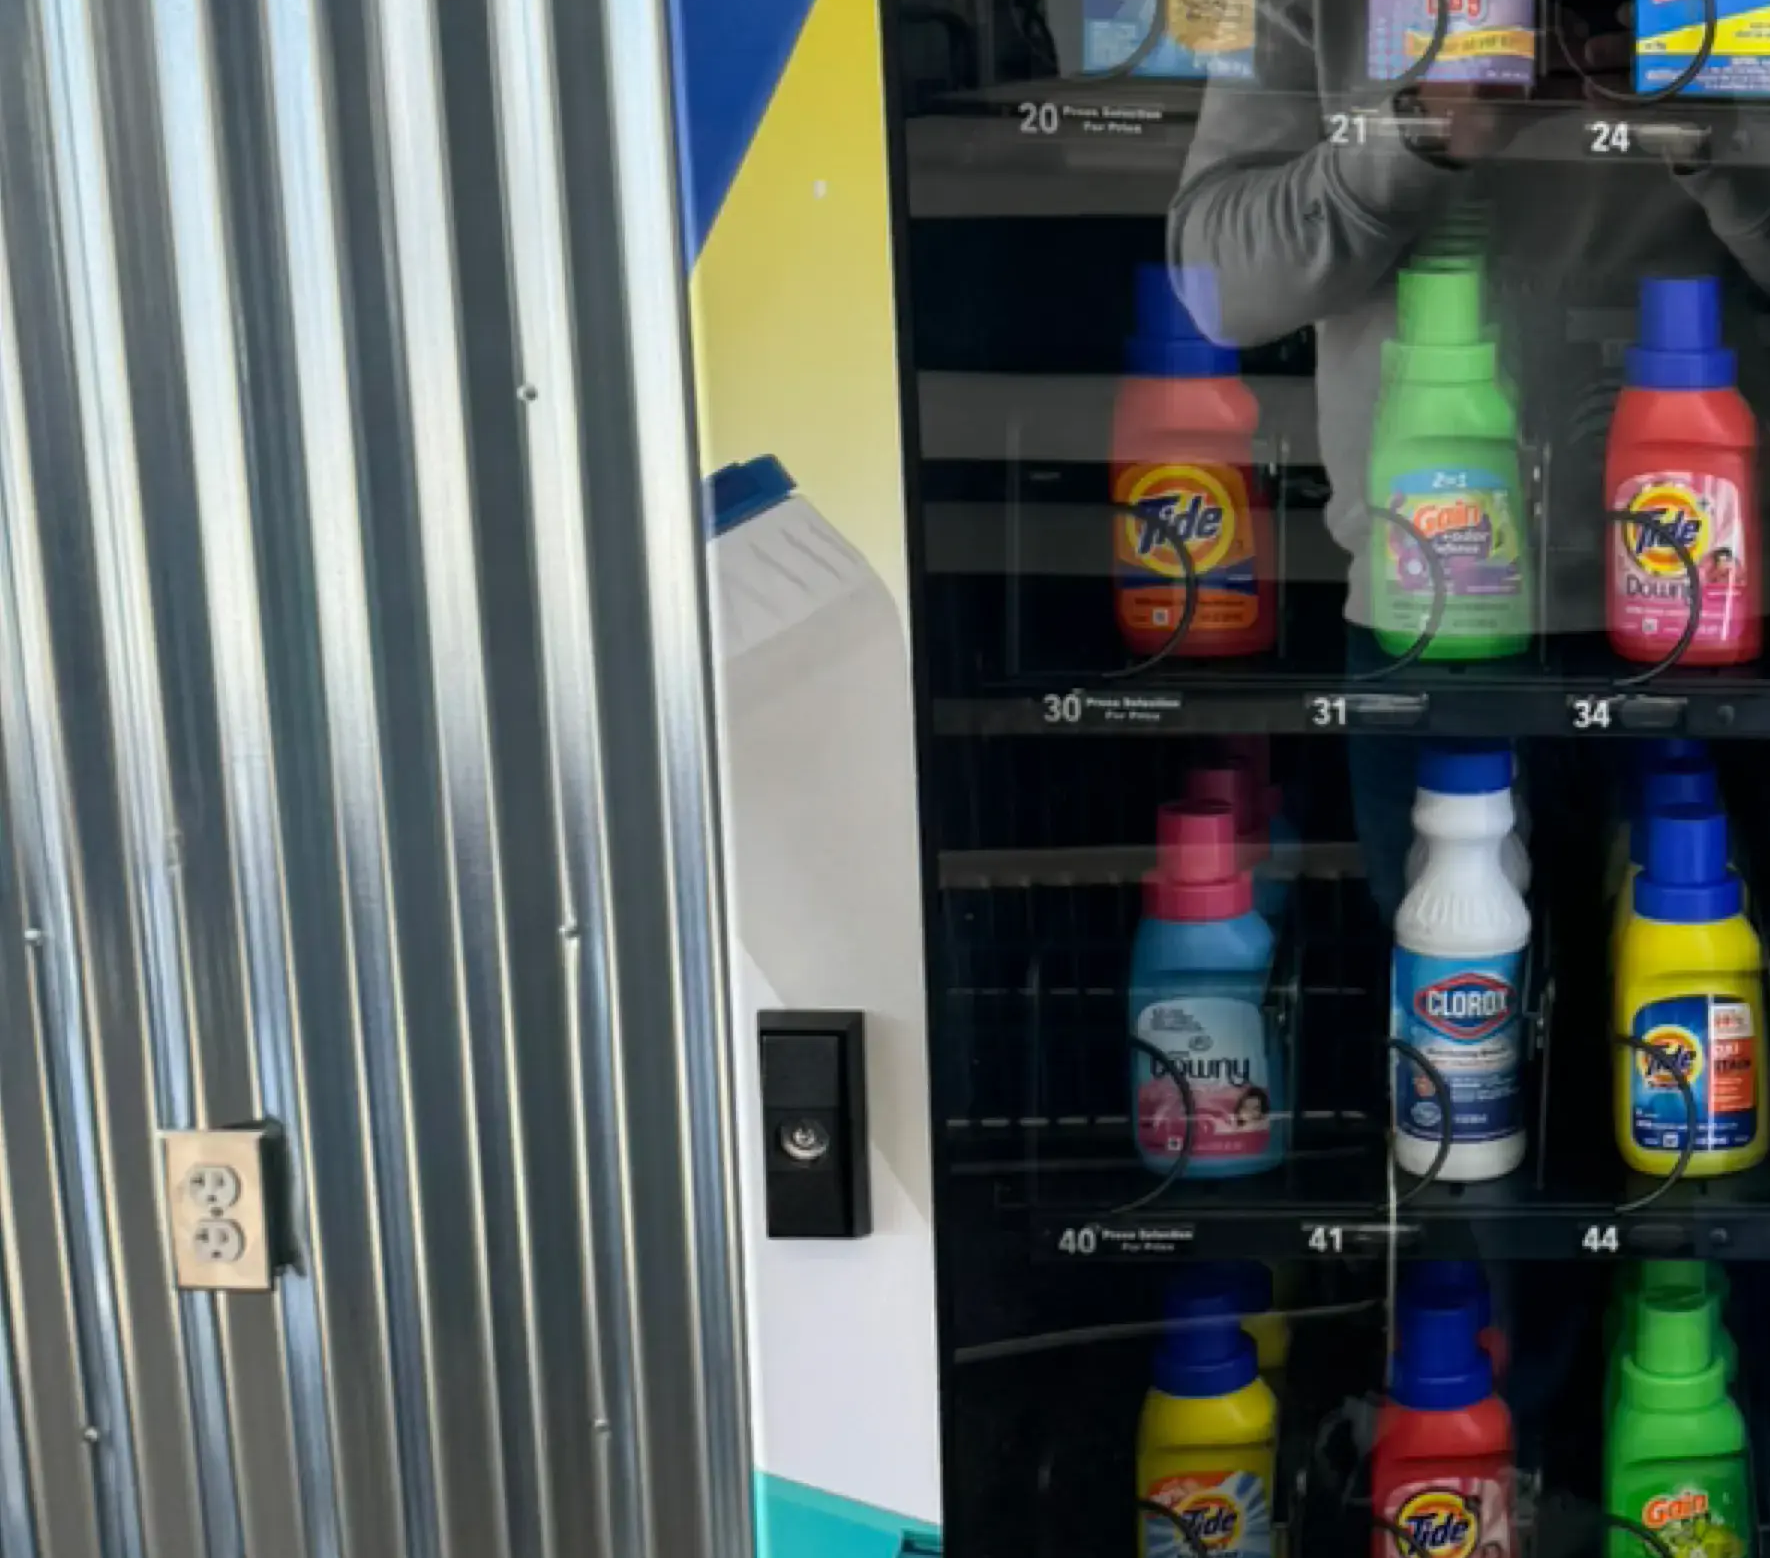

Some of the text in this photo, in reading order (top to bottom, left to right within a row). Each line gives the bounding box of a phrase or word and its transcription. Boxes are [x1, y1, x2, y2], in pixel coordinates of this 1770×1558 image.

[1019, 102, 1060, 134] 20
[1329, 113, 1366, 144] 21
[1590, 121, 1631, 152] 24
[1136, 493, 1224, 554] Tide
[1414, 499, 1481, 539] Gain
[1043, 693, 1082, 722] 30
[1312, 697, 1347, 725] 31
[1573, 699, 1611, 729] 34
[1427, 989, 1508, 1017] CLOROX
[1151, 1057, 1250, 1086] Downy
[1647, 1044, 1696, 1075] Te
[1058, 1227, 1097, 1253] 40
[1308, 1227, 1343, 1253] 41
[1582, 1225, 1619, 1253] 44
[1181, 1507, 1238, 1541] Tide
[1643, 1492, 1709, 1530] Gain
[1405, 1512, 1470, 1556] Tide
